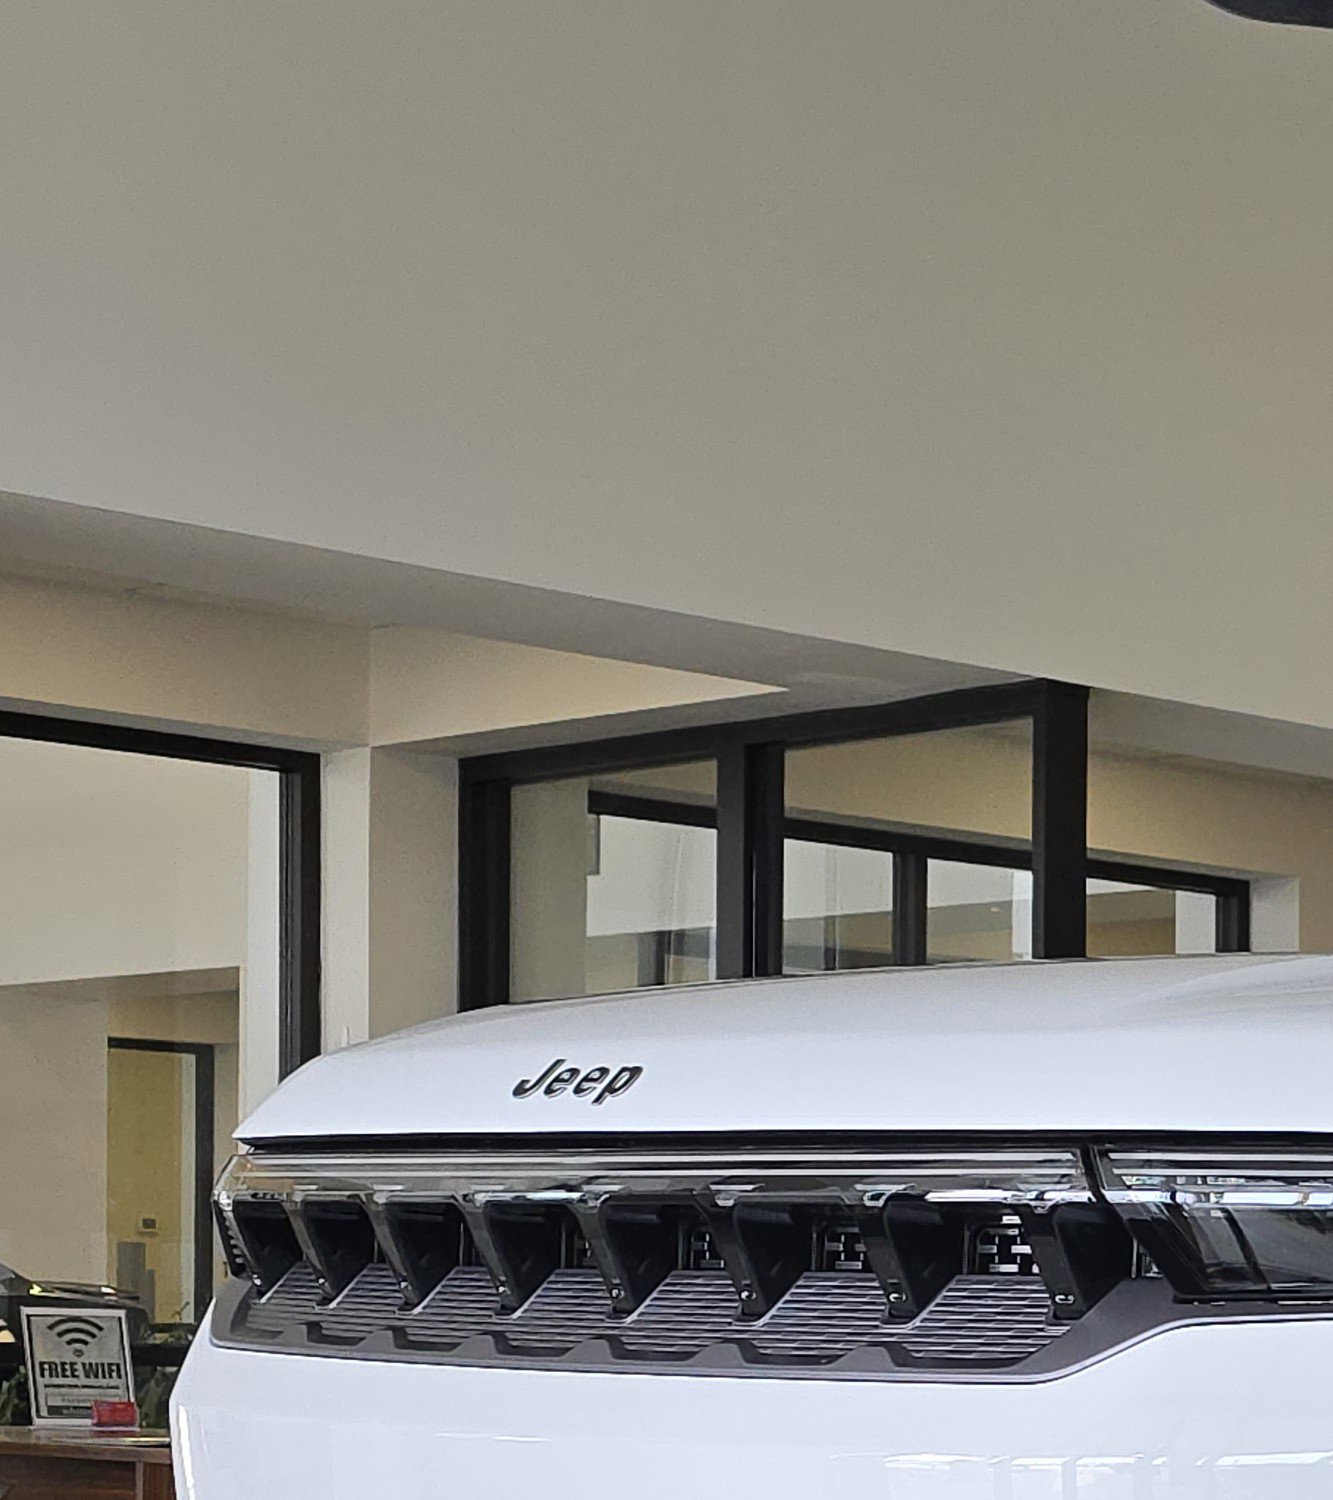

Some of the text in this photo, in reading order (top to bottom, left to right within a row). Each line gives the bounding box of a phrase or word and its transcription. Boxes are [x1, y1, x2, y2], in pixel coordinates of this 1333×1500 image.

[512, 1058, 644, 1106] Jeep
[39, 1360, 122, 1380] FREE WIFI
